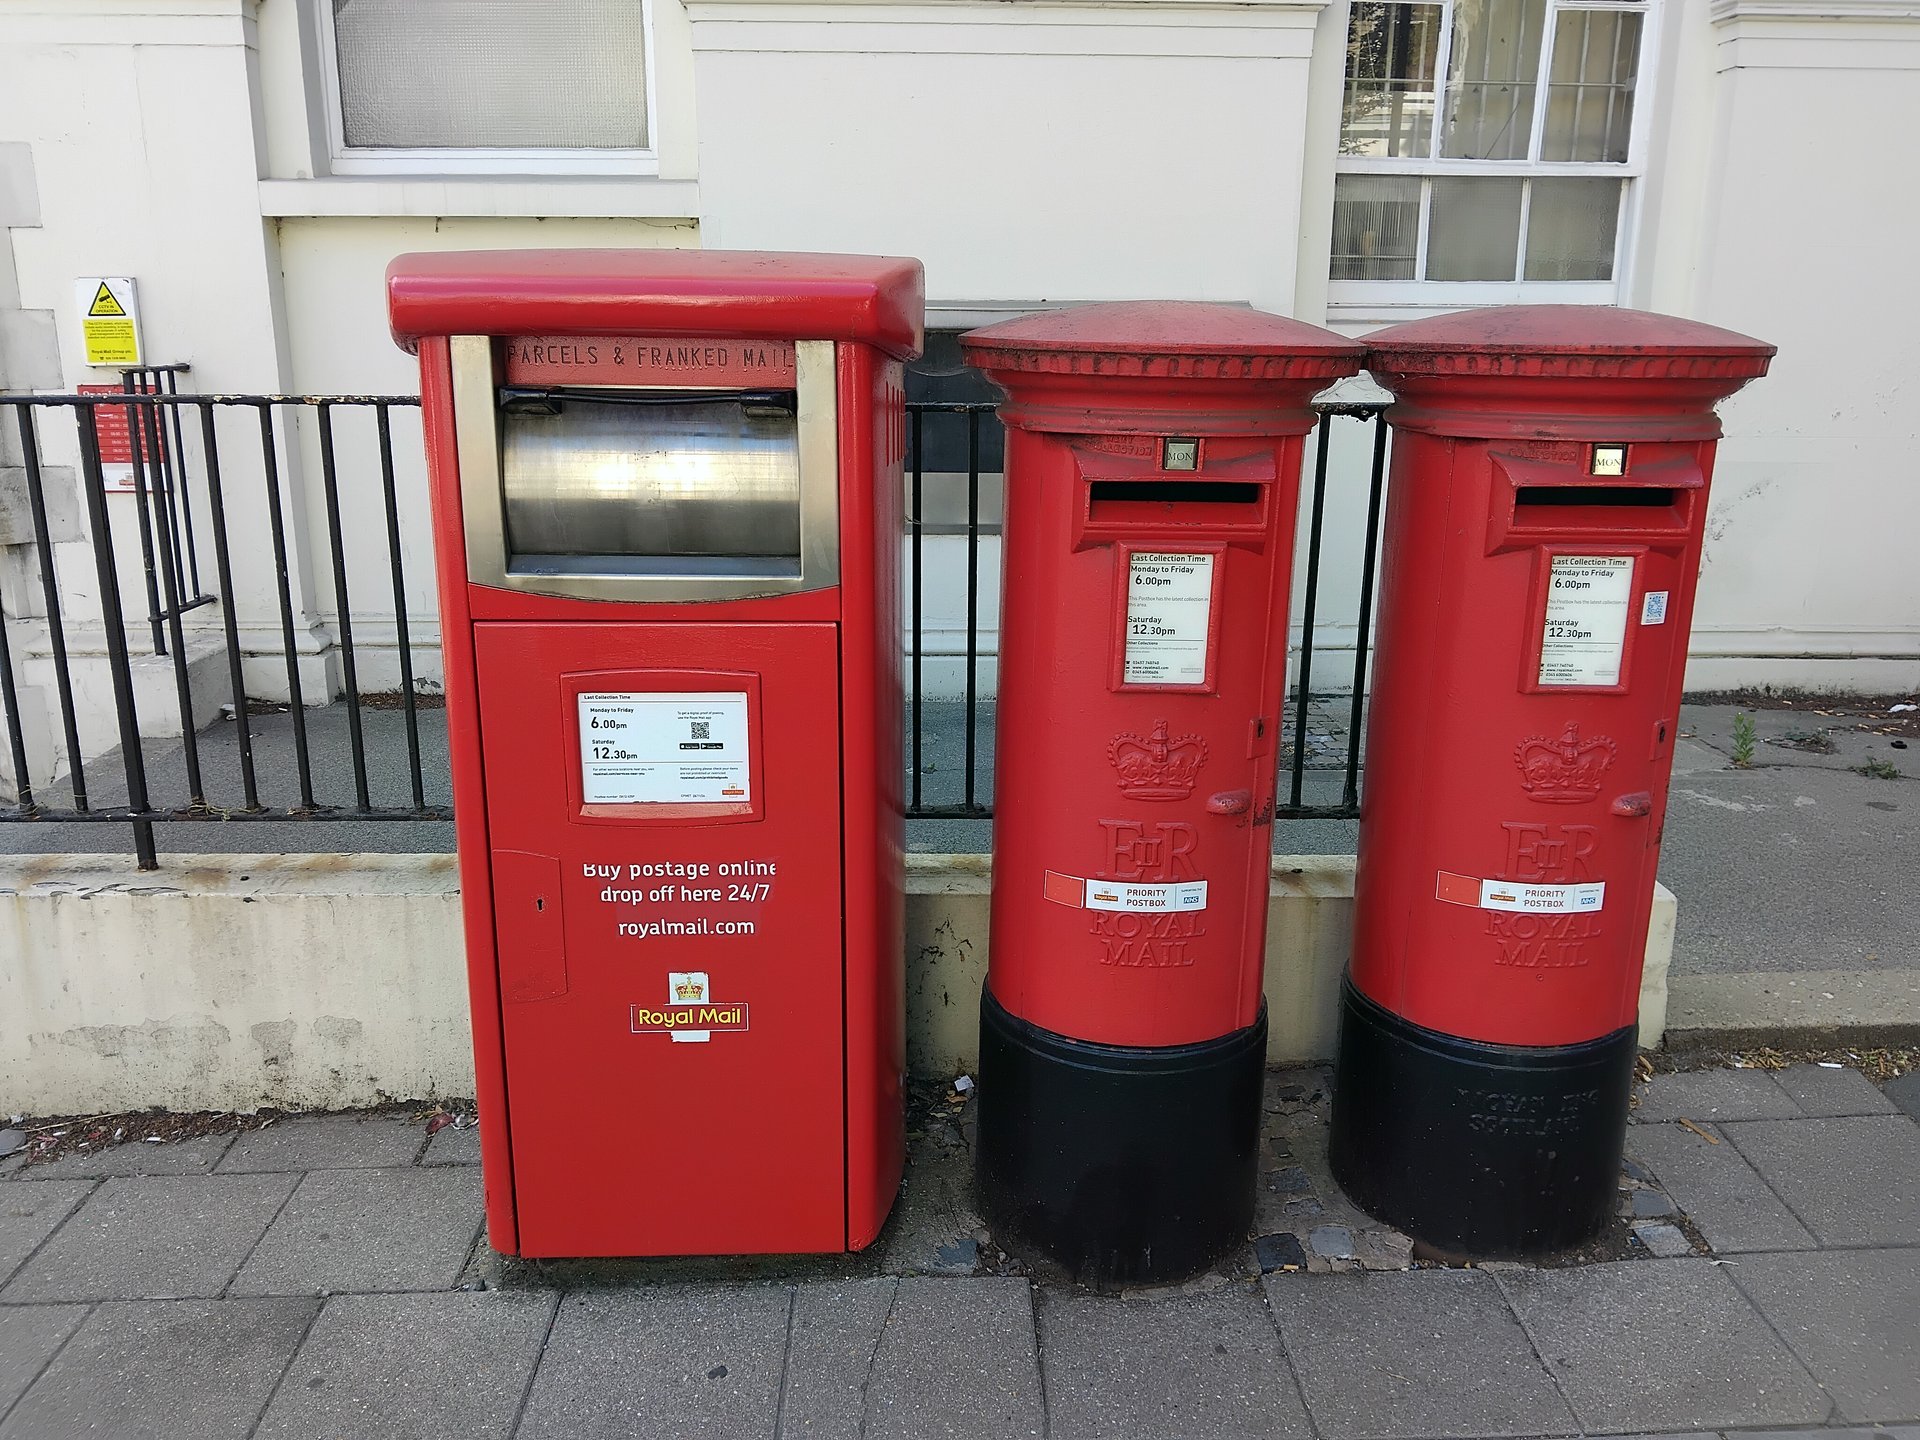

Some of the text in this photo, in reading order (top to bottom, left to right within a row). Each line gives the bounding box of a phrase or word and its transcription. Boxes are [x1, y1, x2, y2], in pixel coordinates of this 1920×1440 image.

[508, 346, 794, 369] PARCELS & FRANKED MAIL
[1168, 452, 1192, 461] MON
[1596, 458, 1621, 467] MON
[1131, 565, 1160, 574] Monday
[1171, 566, 1194, 574] Friday
[1551, 569, 1580, 577] Monday
[1135, 575, 1171, 586] 6.00pm
[1555, 578, 1590, 590] 6.00pm
[1128, 616, 1162, 625] Saturday
[1545, 619, 1579, 627] Saturday
[1132, 625, 1176, 636] 12.30pm
[1549, 627, 1592, 639] 12.30pm
[591, 716, 627, 730] 6.00pm
[594, 747, 638, 760] 12.30pm
[584, 864, 621, 880] Buy
[630, 862, 710, 880] postage
[600, 884, 770, 905] drop off here 24/7
[1127, 888, 1167, 897] PRIORITY
[619, 918, 755, 938] royalmail.com
[1090, 911, 1206, 938] ROYAL
[1485, 911, 1602, 940] ROYAL
[1100, 940, 1195, 968] MAIL
[1494, 940, 1588, 968] MAIL
[639, 1008, 741, 1028] Royal Mail
